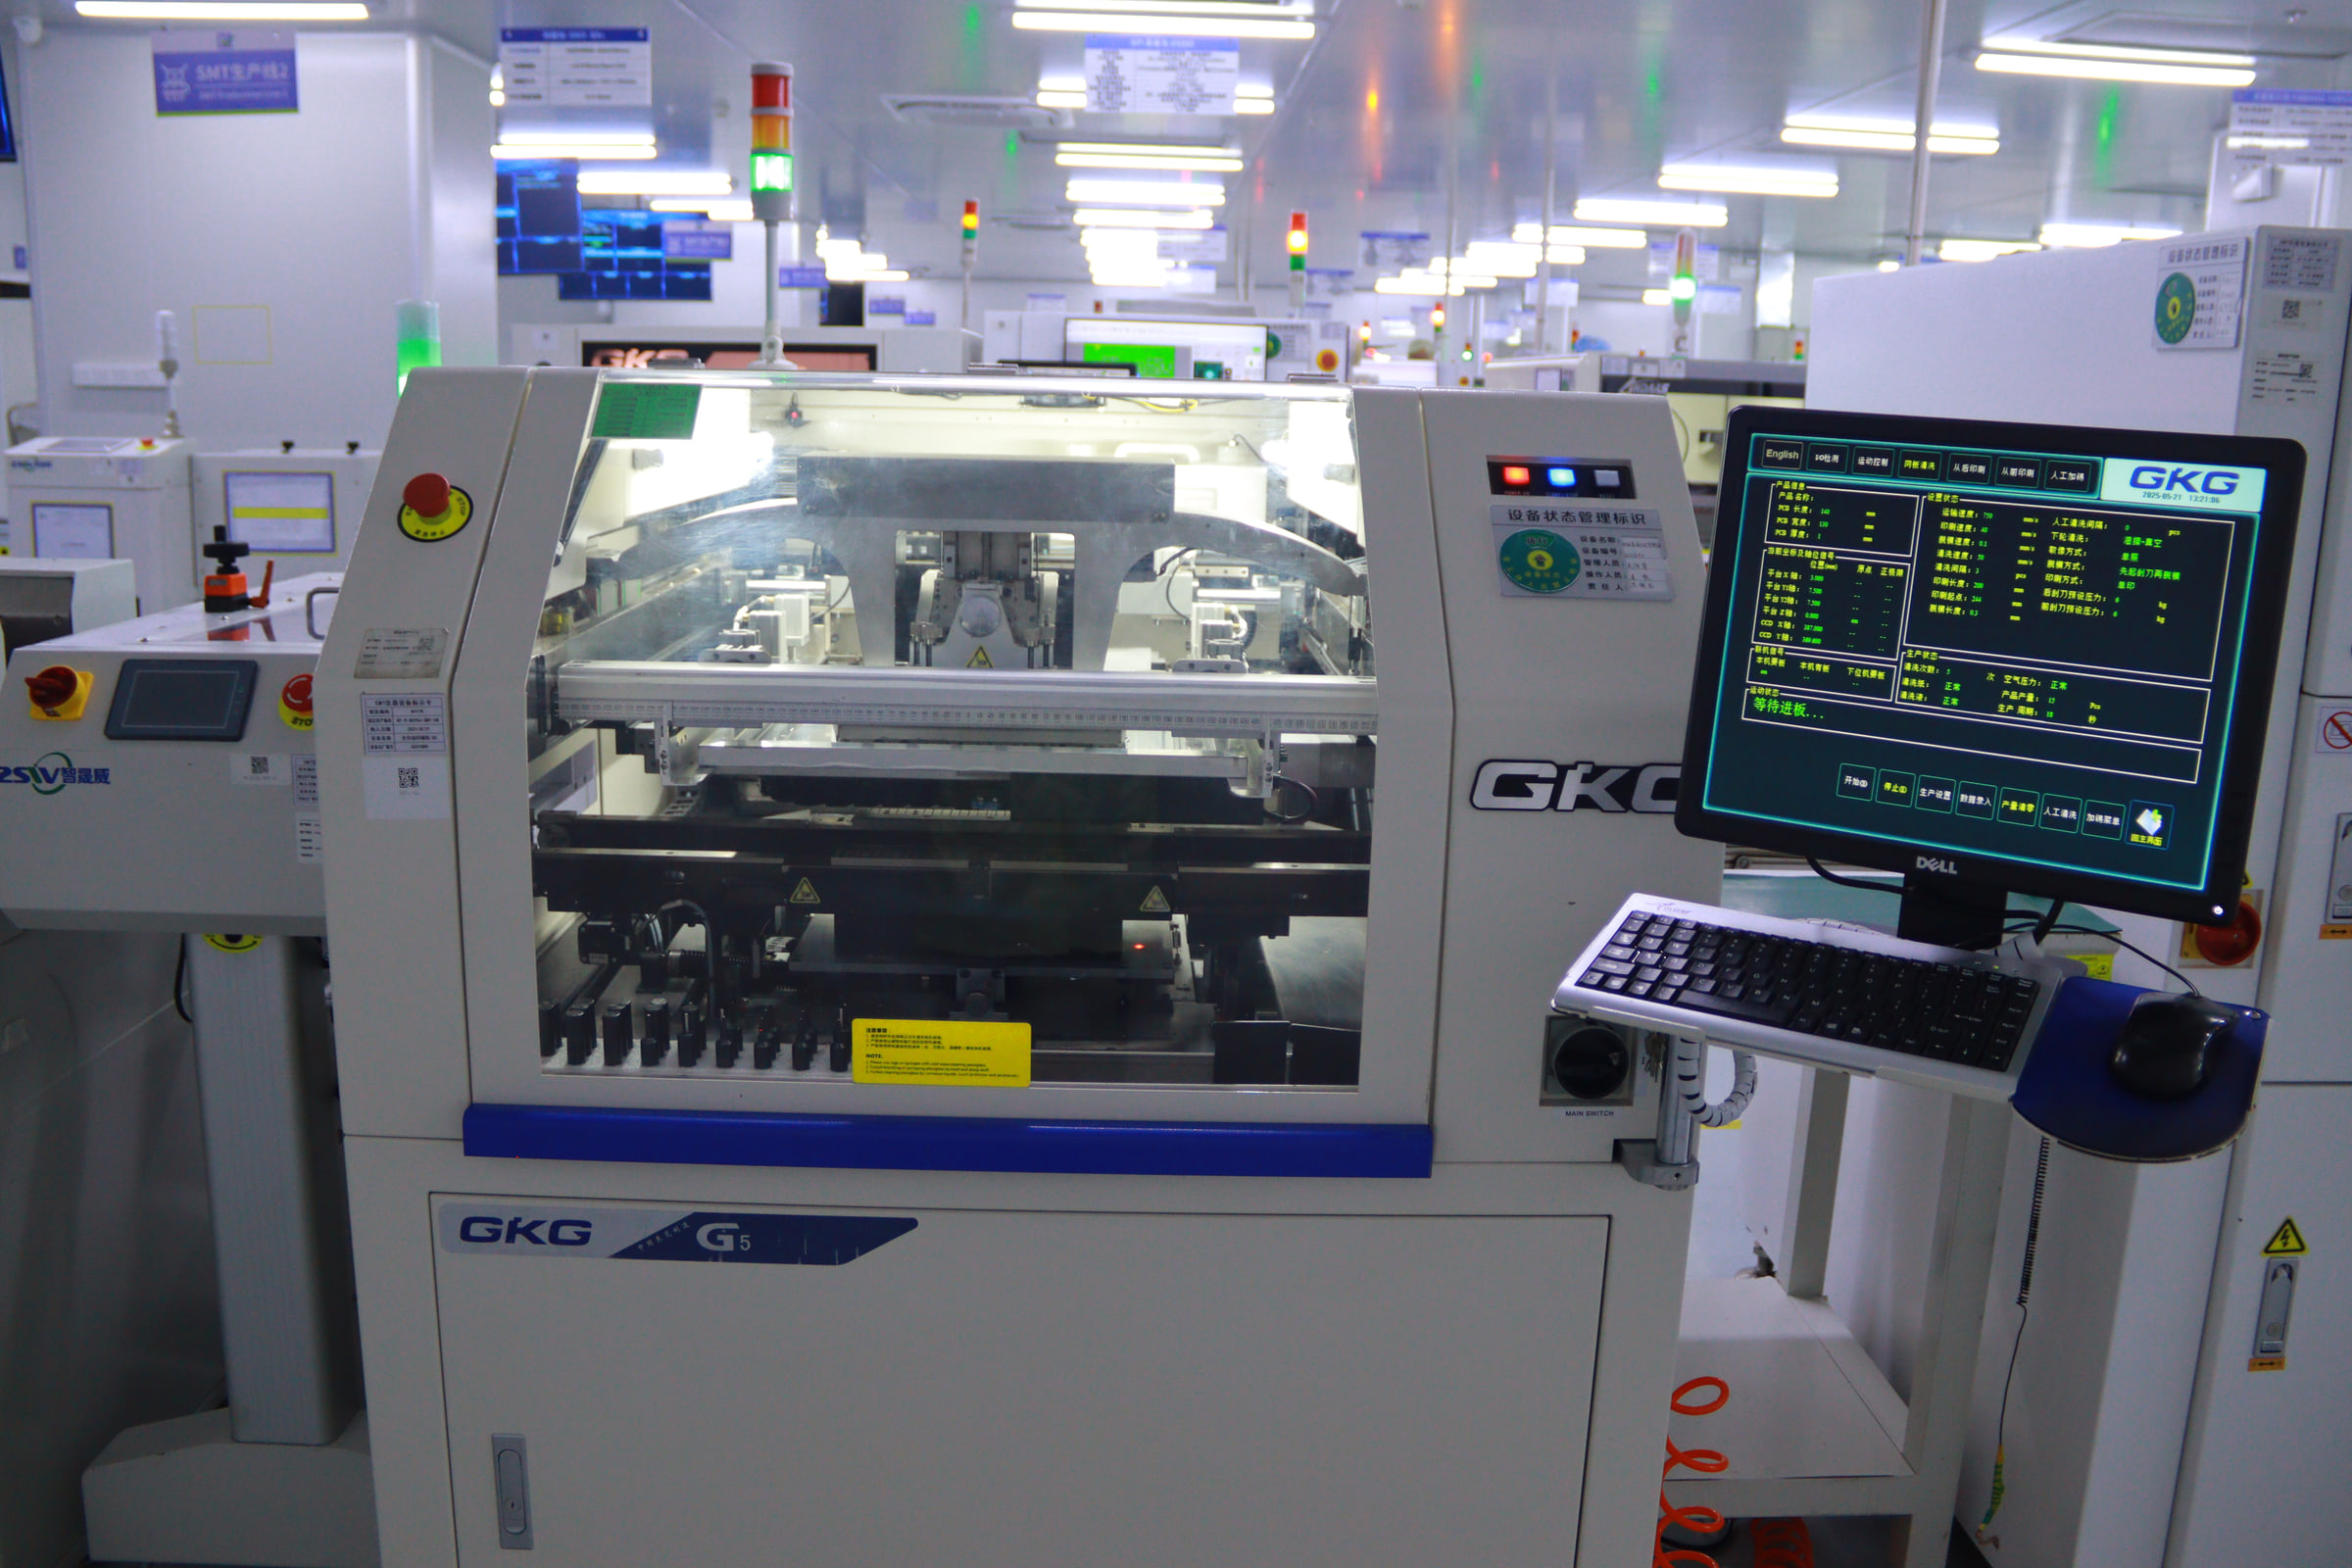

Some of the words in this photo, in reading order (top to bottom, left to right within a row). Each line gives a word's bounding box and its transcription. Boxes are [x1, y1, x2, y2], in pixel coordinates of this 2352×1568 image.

[1766, 449, 1799, 460] English
[1858, 456, 1888, 467] 运动控制
[1953, 464, 1986, 475] 从后印刷
[2001, 466, 2034, 478] 从前印刷
[1776, 480, 1806, 491] 产品信息
[2130, 466, 2240, 495] GKG
[2142, 491, 2181, 501] 2025-05-21
[1508, 509, 1646, 525] 设备状态管理标识
[1906, 650, 1938, 661] 生产状态
[1986, 672, 1995, 681] 次
[2050, 680, 2068, 690] 正常
[1944, 682, 1962, 692] 正常
[1942, 696, 1959, 707] 正常
[291, 716, 314, 726] STO
[1920, 788, 1951, 801] 生产设置
[2043, 807, 2078, 820] 人工清洗
[1916, 856, 1958, 874] DELL
[461, 1216, 592, 1246] GKG
